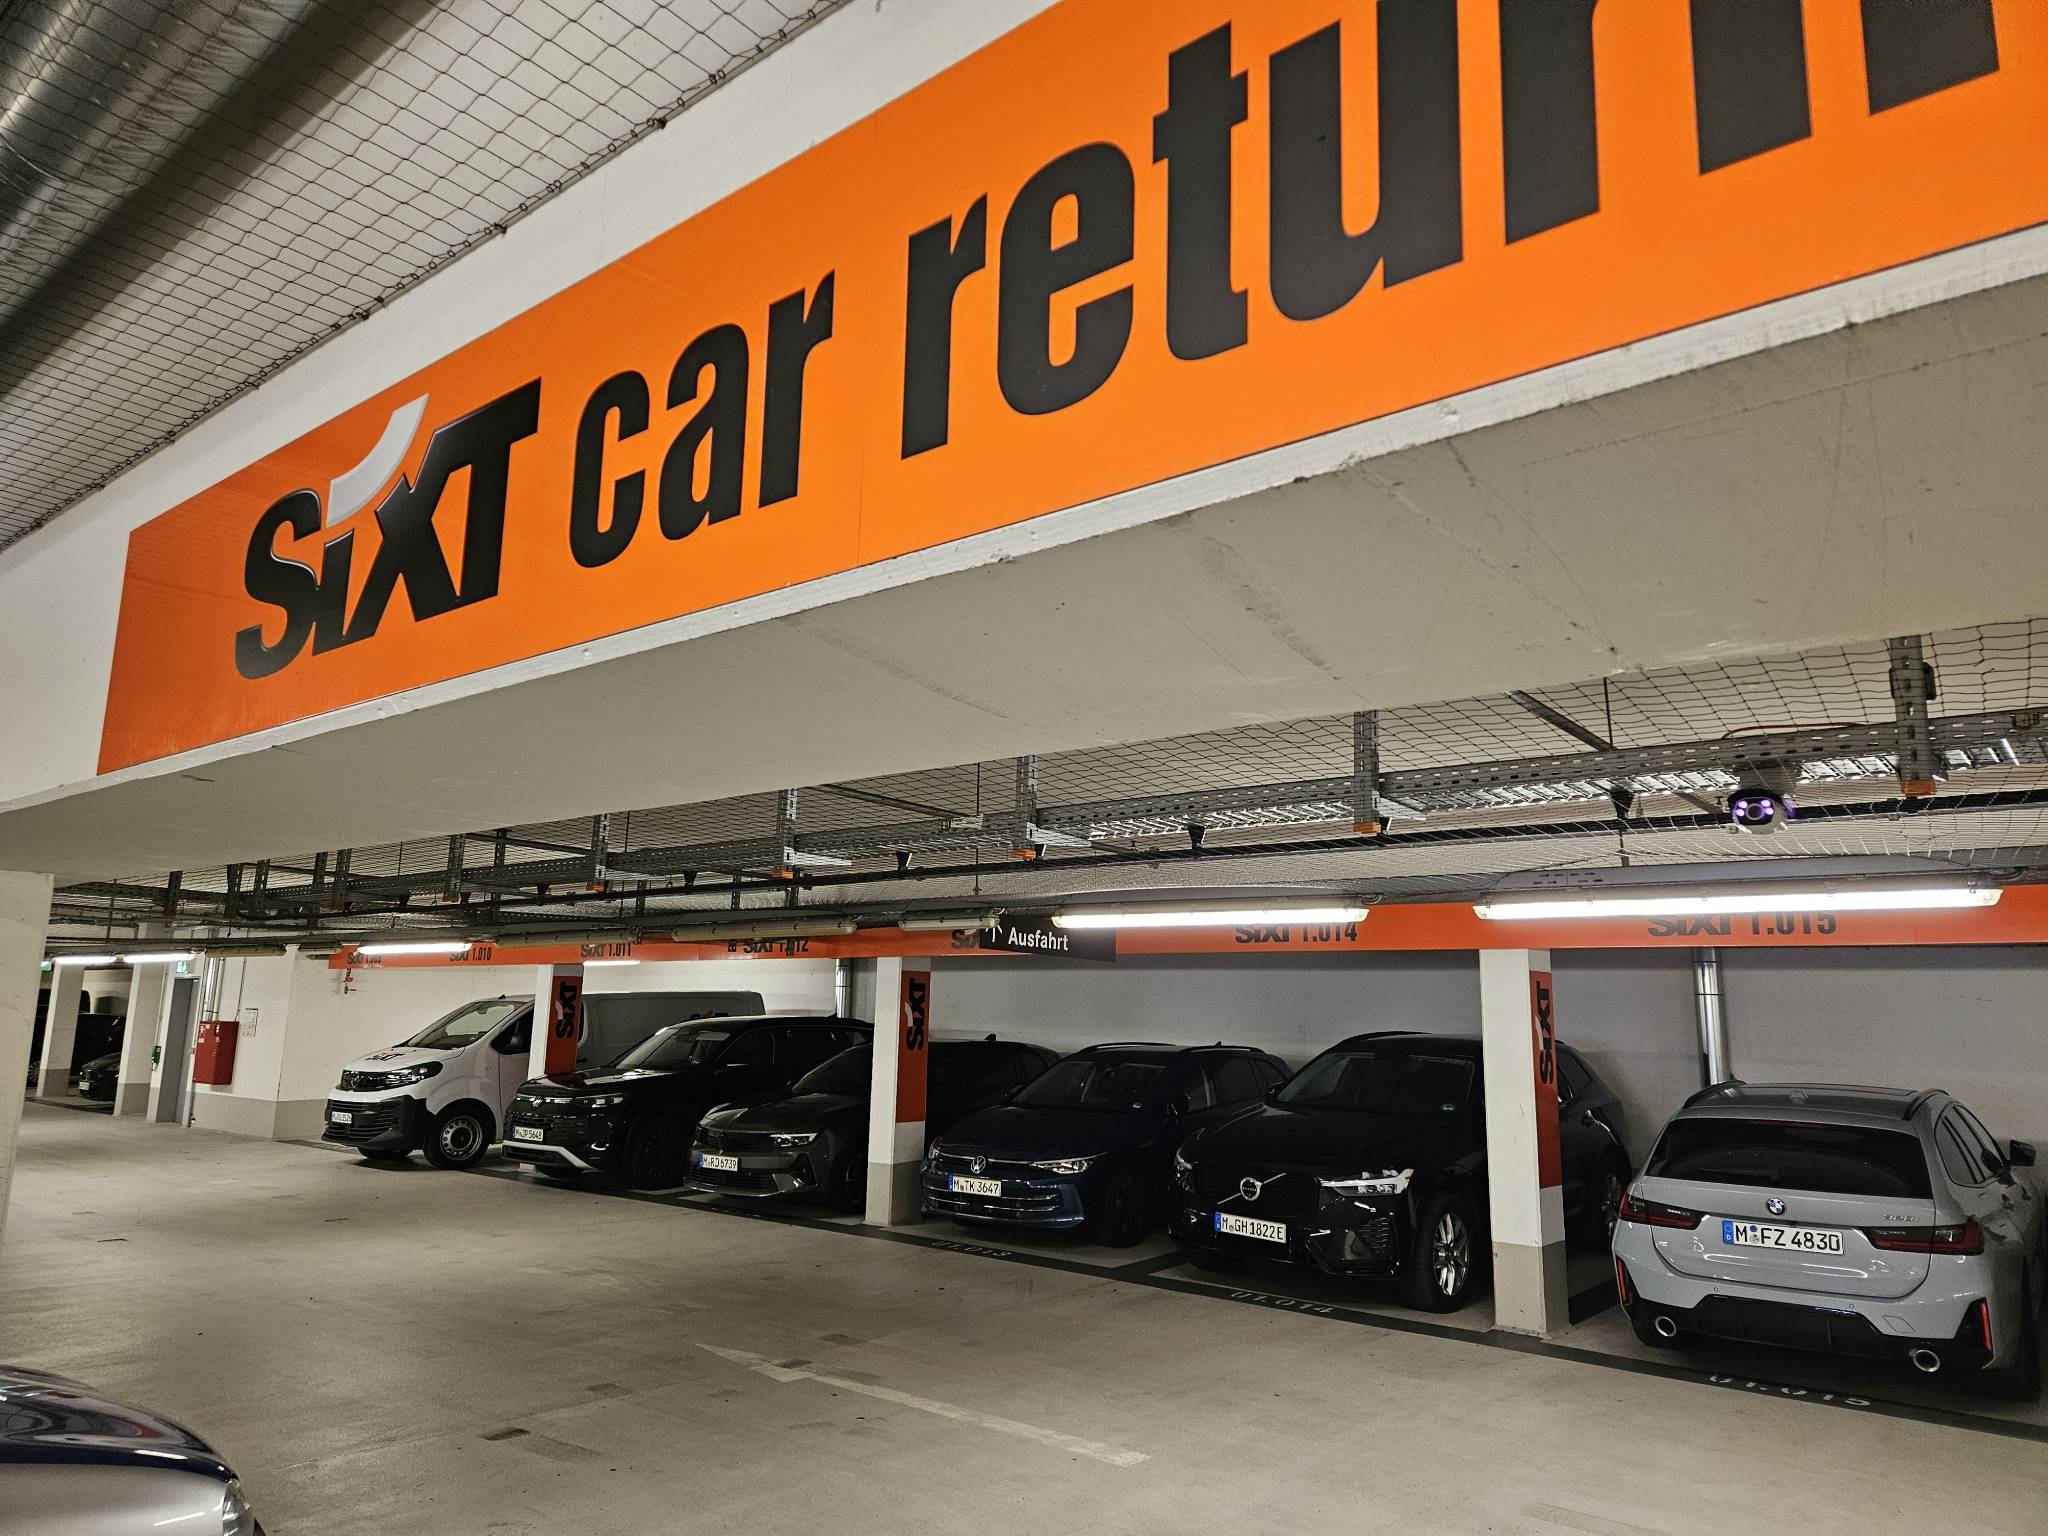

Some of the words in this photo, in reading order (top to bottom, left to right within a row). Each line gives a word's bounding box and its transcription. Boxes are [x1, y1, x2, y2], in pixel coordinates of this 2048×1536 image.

[569, 270, 834, 569] car
[1008, 927, 1069, 951] Ausfahrt
[1303, 921, 1358, 942] 1.014
[472, 947, 492, 961] 1.010
[608, 943, 631, 957] 1.011
[1735, 1225, 1748, 1243] M
[1760, 1227, 1786, 1246] FZ
[1790, 1231, 1842, 1252] 4830
